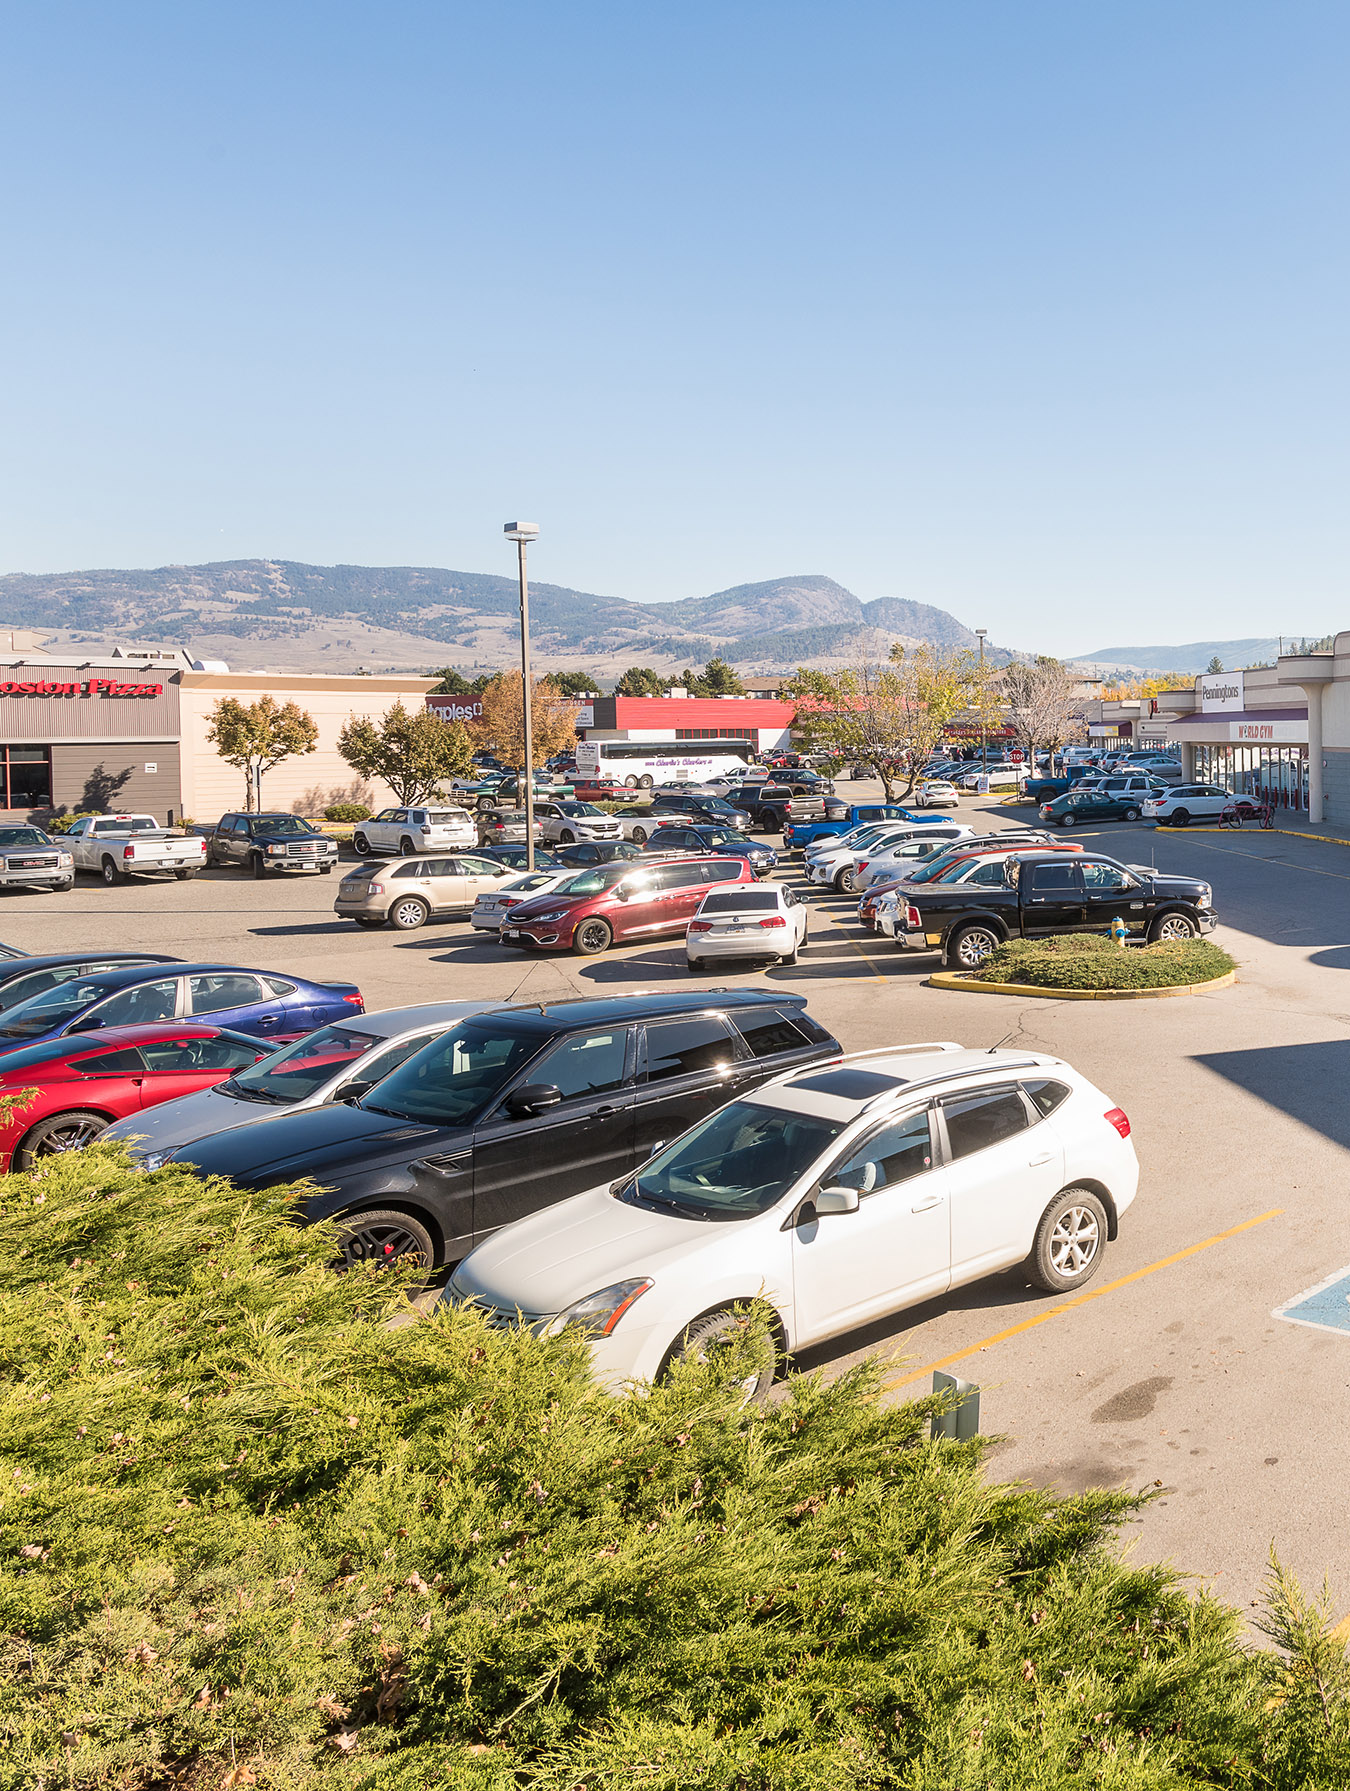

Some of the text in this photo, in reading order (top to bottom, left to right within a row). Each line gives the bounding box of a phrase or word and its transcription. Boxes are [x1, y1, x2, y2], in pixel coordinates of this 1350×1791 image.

[0, 678, 163, 695] oston Pizza
[1202, 683, 1239, 703] Penningtons
[428, 703, 473, 723] taples
[1260, 725, 1274, 739] GYM
[1009, 753, 1025, 761] STOP
